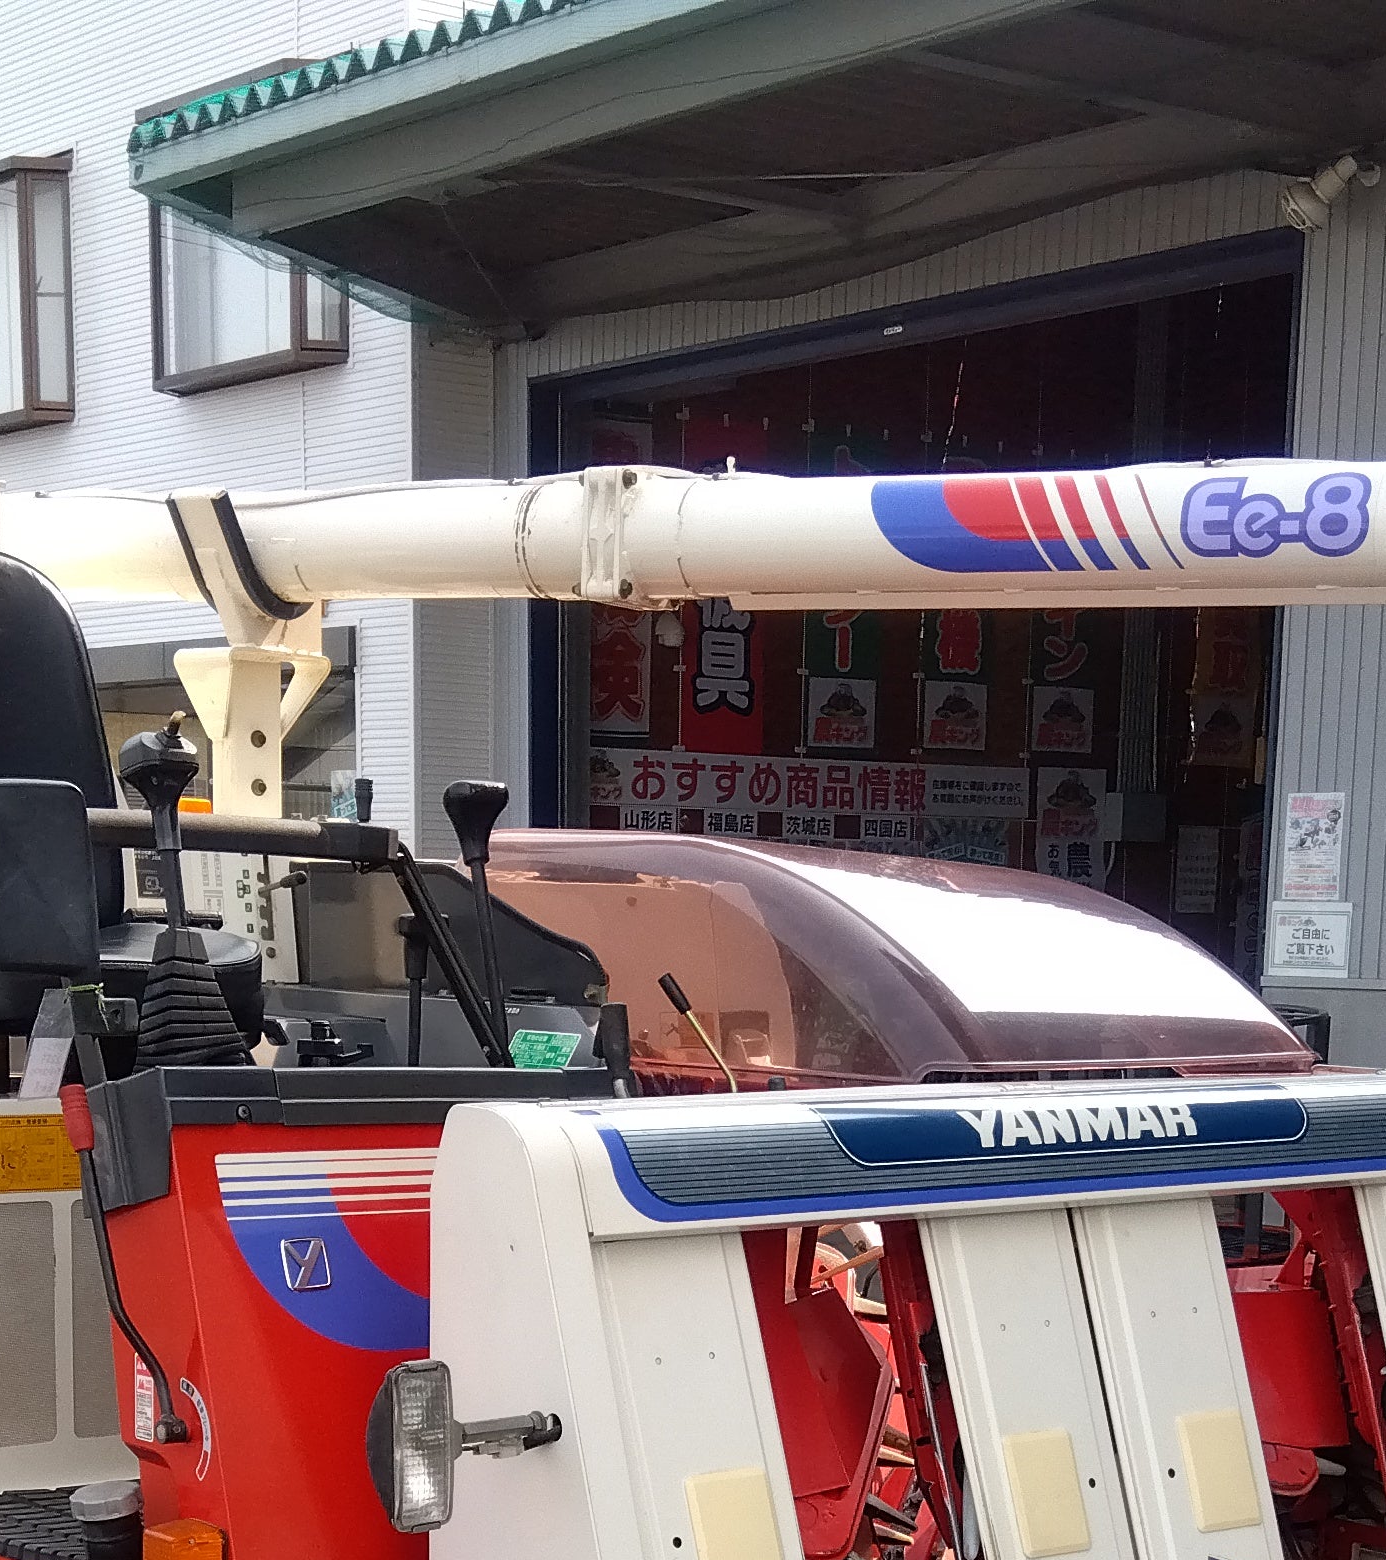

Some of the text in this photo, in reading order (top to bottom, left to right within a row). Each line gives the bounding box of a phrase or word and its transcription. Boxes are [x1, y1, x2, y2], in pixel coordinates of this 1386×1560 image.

[1179, 471, 1371, 557] Ee-8
[631, 755, 926, 811] おすすめ商品情報
[625, 810, 673, 831] 山形店
[707, 812, 755, 834] 福島店
[864, 819, 907, 839] 四国店
[1291, 928, 1330, 940] ご自由に
[956, 1104, 1198, 1149] YANMAR
